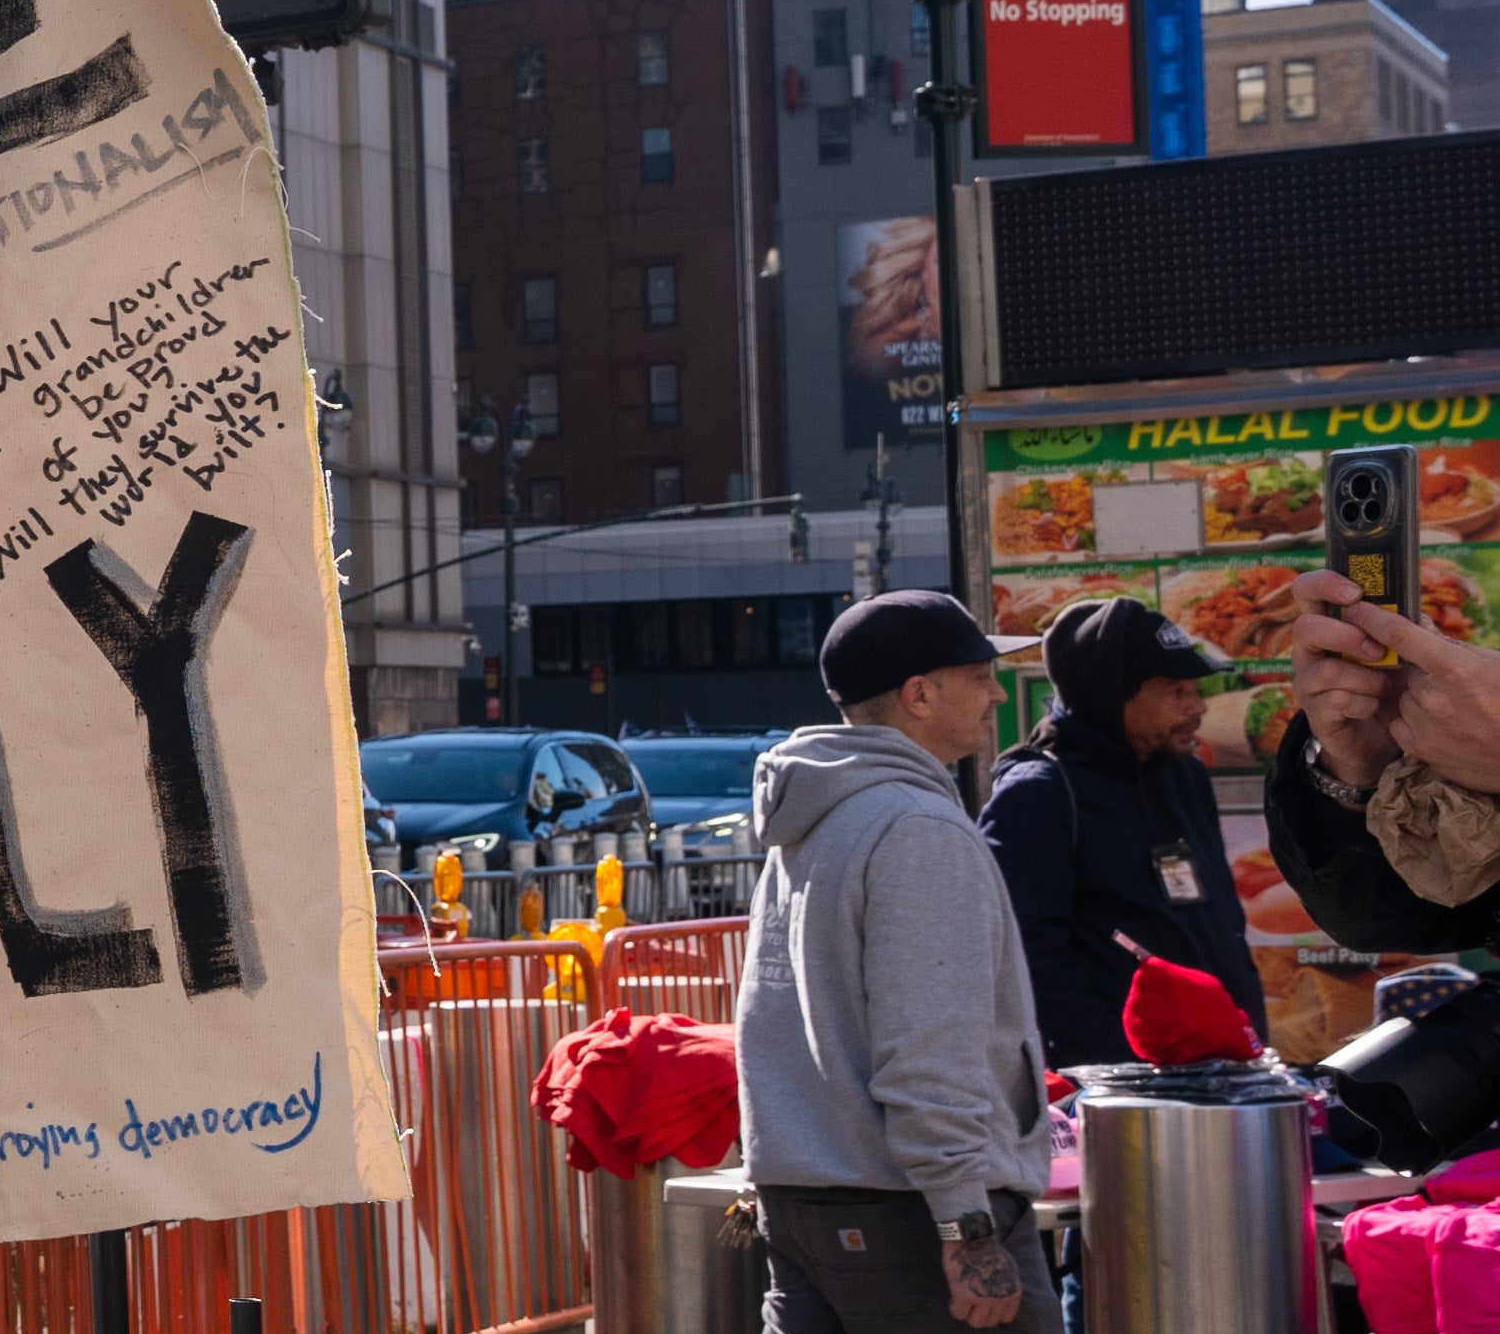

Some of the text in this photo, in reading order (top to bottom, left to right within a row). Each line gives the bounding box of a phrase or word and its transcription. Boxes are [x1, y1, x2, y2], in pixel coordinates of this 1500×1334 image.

[990, 0, 1021, 22] No
[90, 260, 183, 342] your
[59, 452, 139, 515] they
[235, 324, 292, 366] the
[71, 379, 128, 421] be
[206, 370, 263, 427] you
[1127, 394, 1491, 451] HALAL FOOD
[43, 437, 79, 482] of
[1297, 948, 1335, 964] Beef
[117, 1050, 322, 1159] democracy
